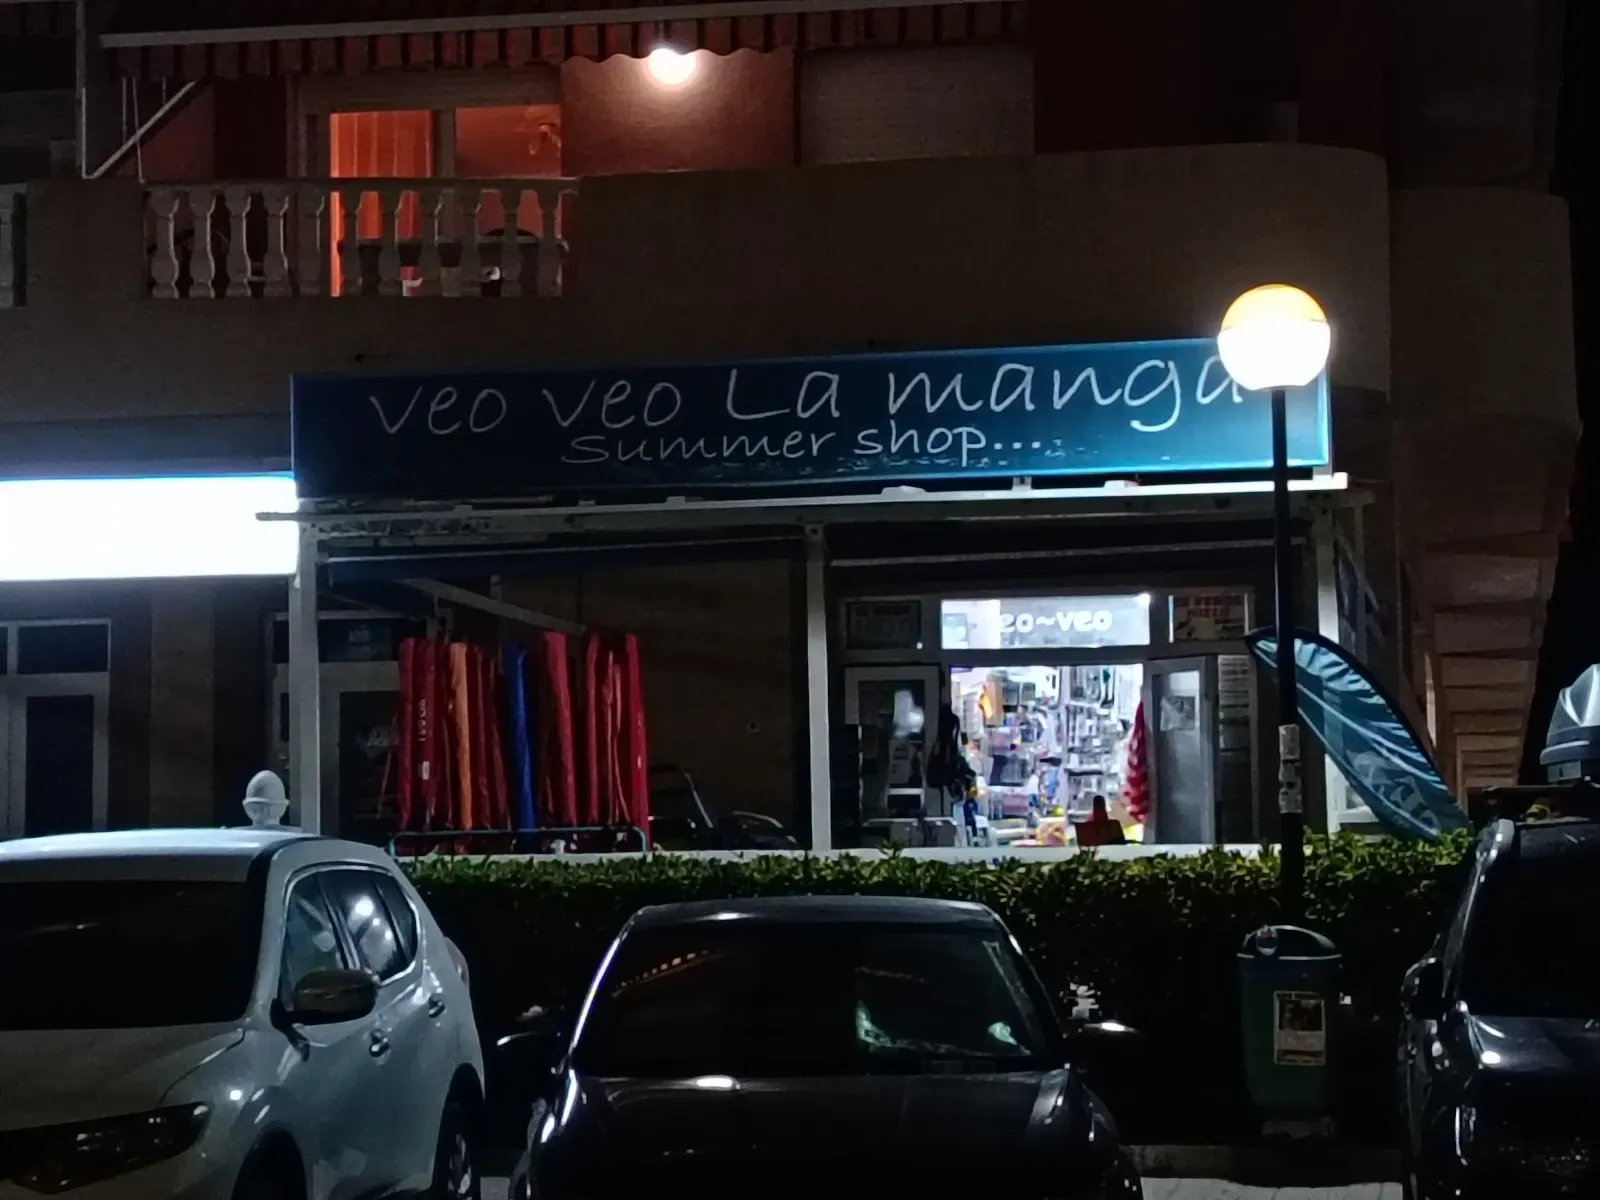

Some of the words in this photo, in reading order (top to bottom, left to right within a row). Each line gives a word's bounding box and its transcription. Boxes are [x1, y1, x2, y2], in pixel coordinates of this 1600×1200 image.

[726, 368, 840, 420] La
[888, 359, 1243, 432] manga
[560, 431, 837, 464] summer
